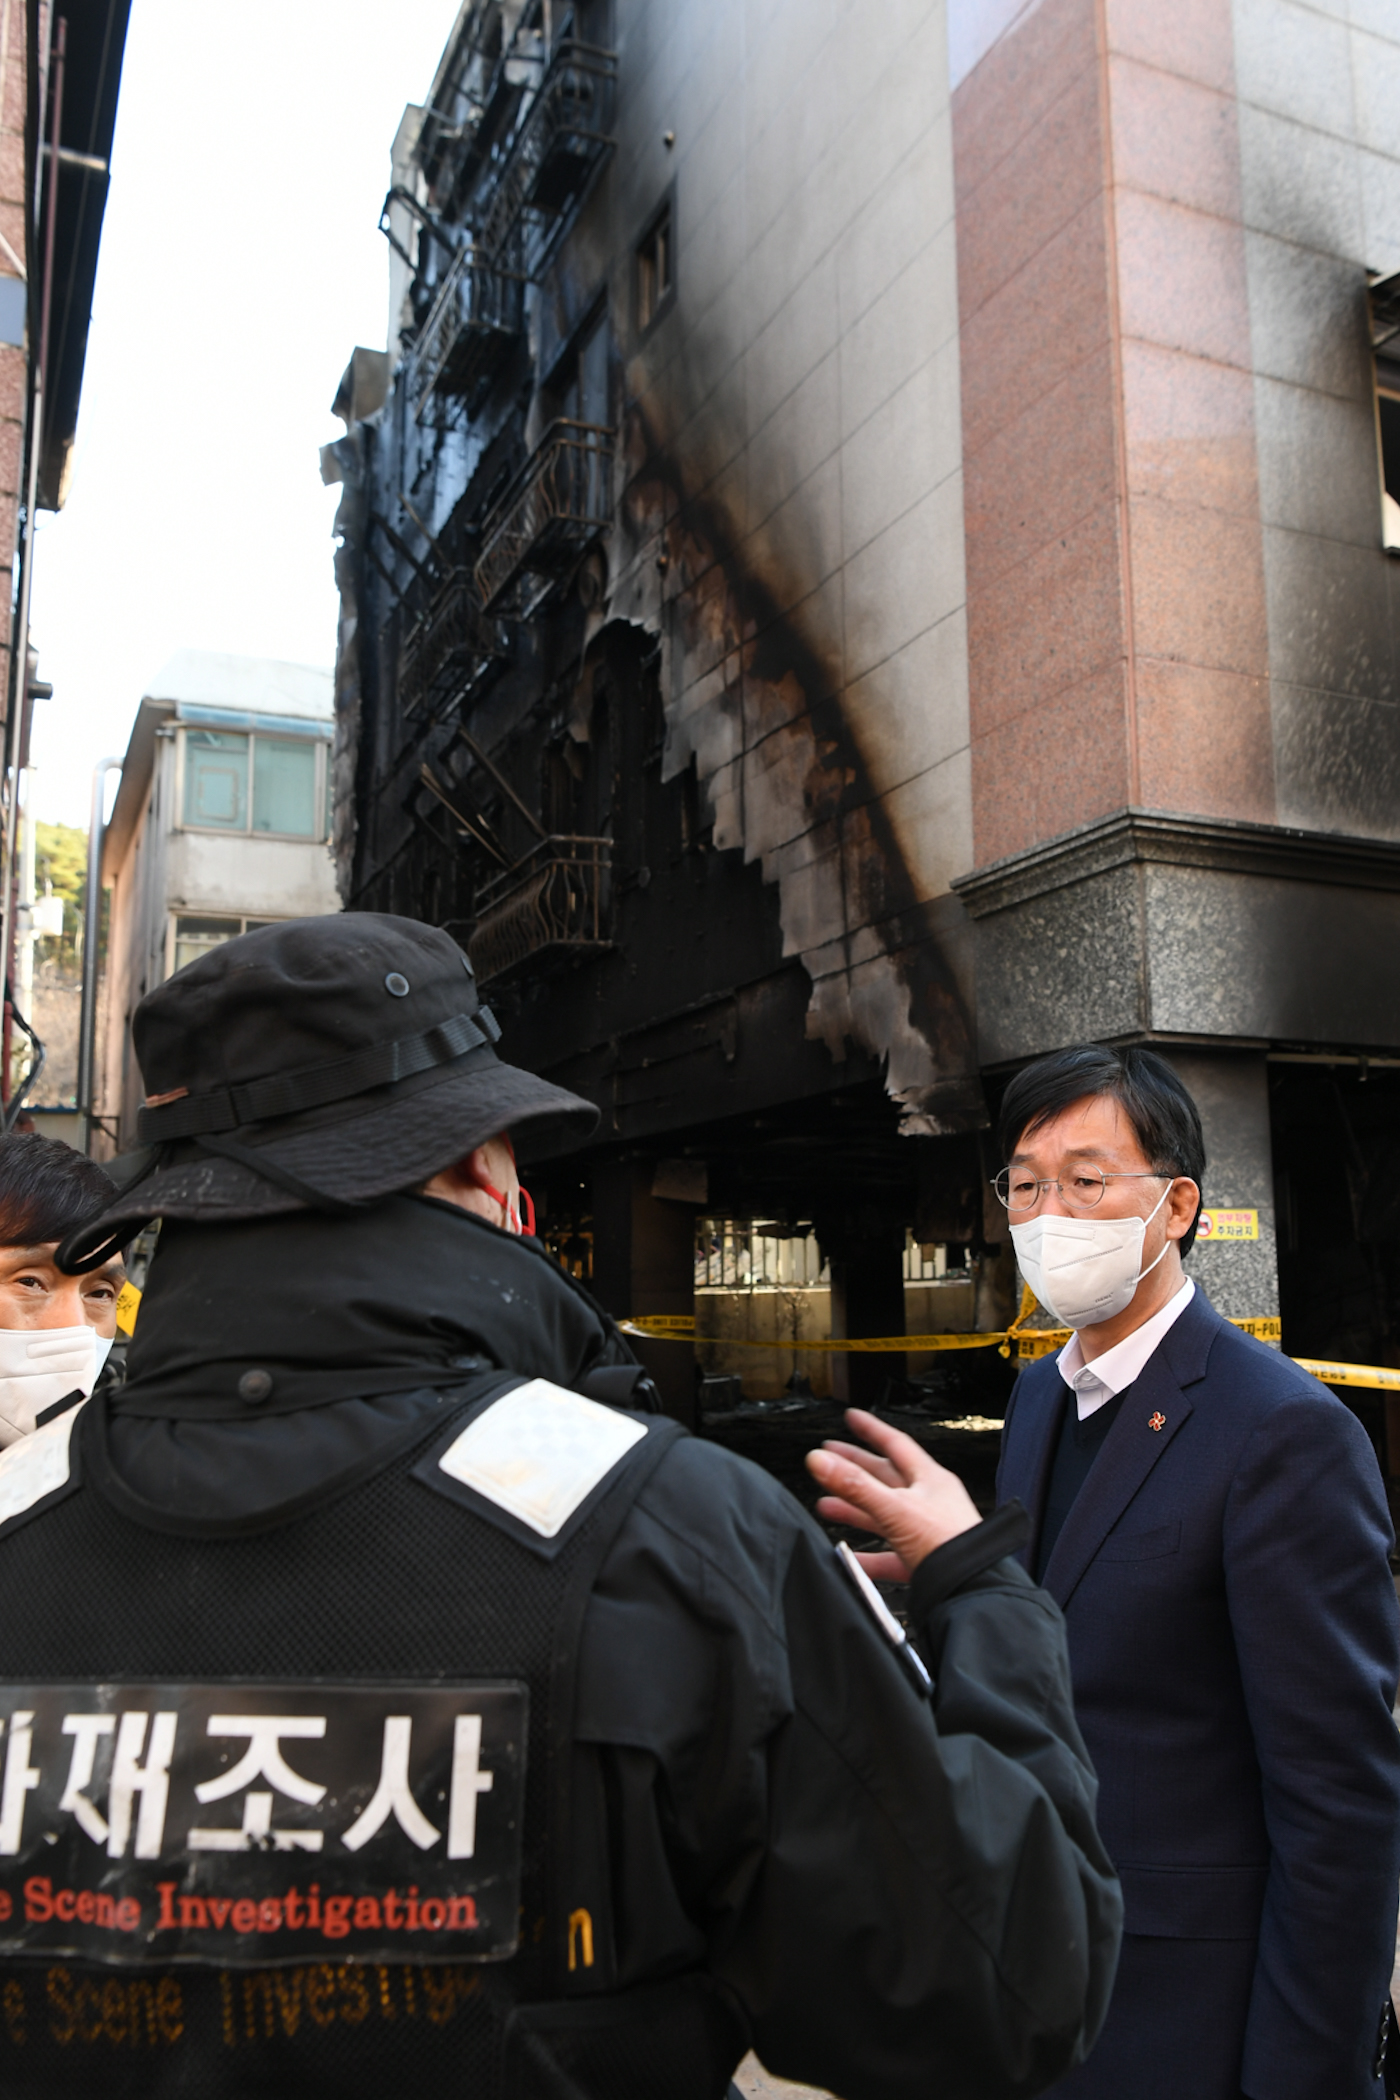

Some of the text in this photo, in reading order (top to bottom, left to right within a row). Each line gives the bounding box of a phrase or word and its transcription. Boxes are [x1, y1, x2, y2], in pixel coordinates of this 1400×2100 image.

[1217, 1225, 1253, 1236] 주차금지
[23, 1876, 142, 1932] Scene
[155, 1880, 479, 1940] Investigation
